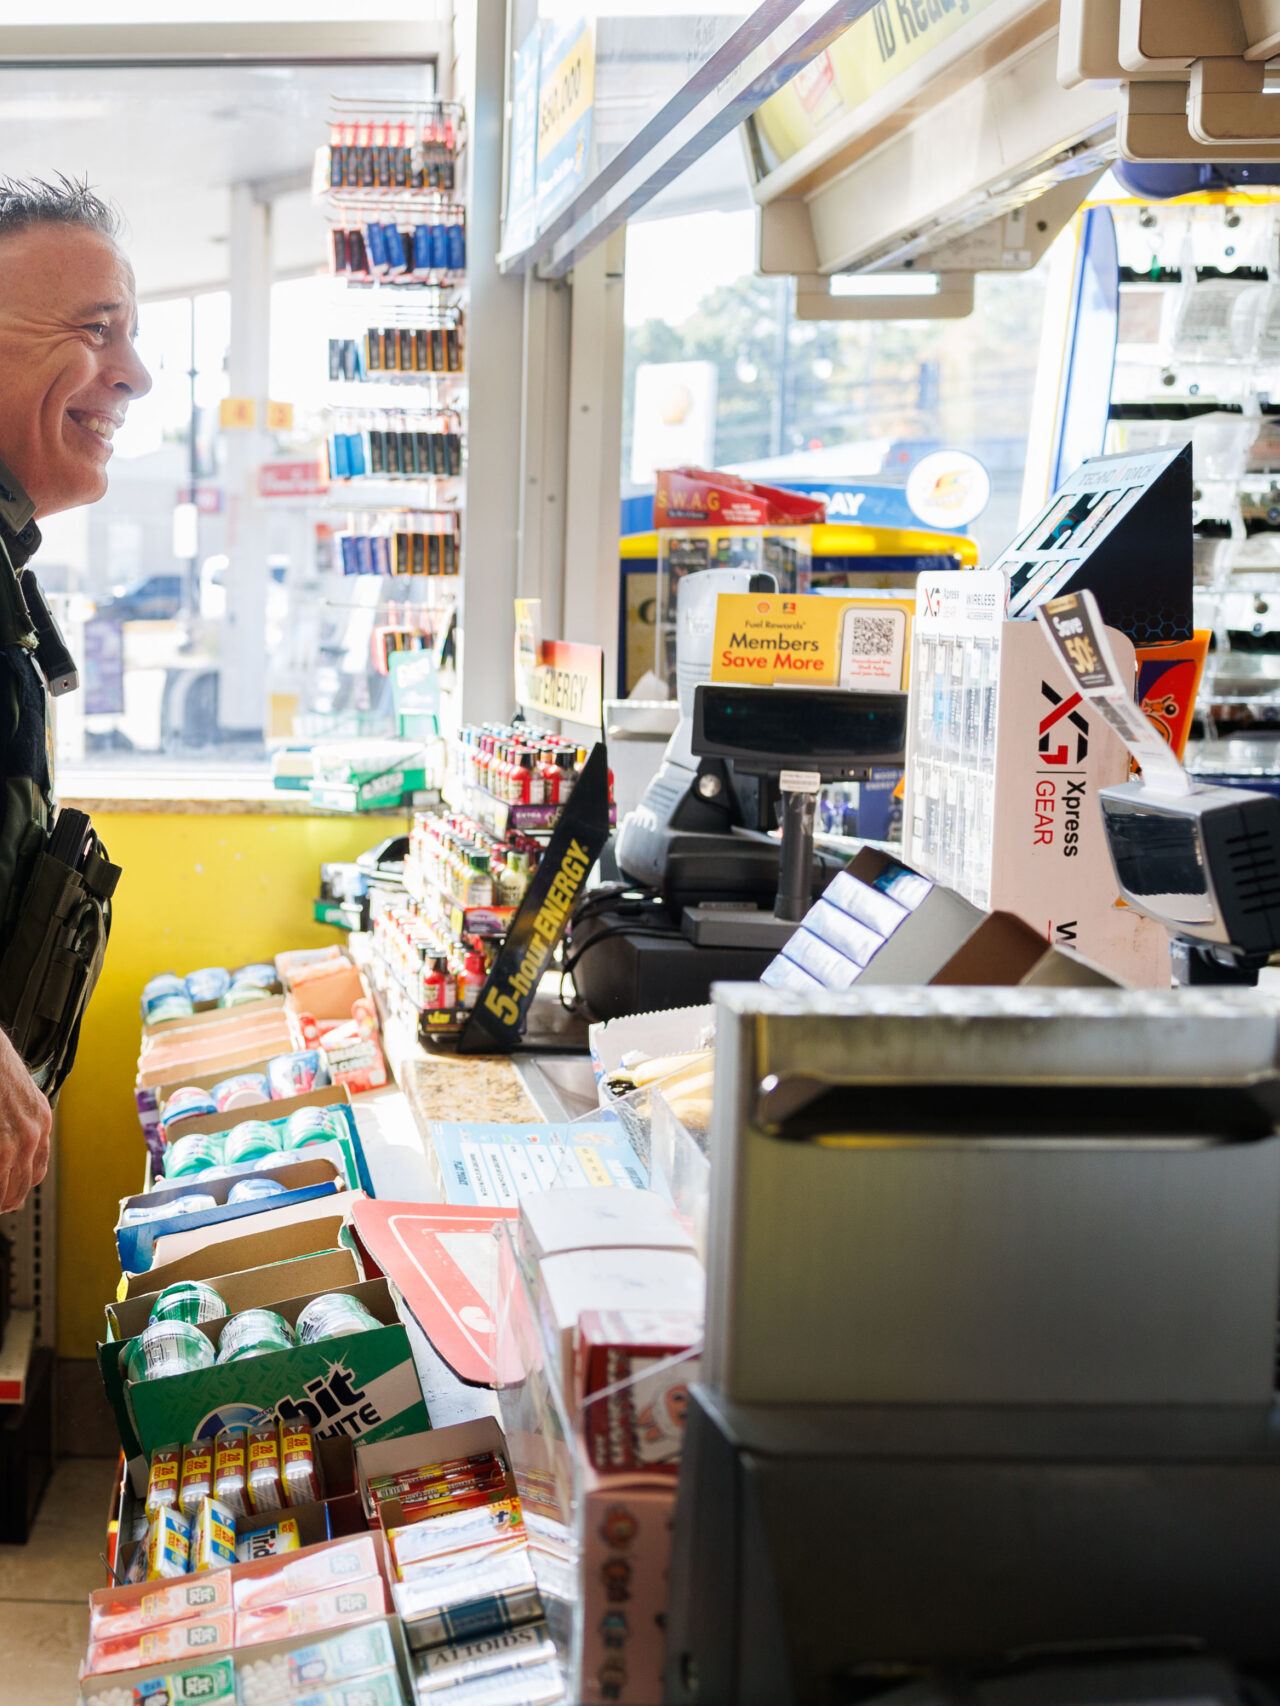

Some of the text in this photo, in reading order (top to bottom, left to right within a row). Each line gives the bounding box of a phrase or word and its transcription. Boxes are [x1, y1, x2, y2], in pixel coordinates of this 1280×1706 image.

[745, 620, 763, 629] Fuel
[1052, 616, 1083, 638] Save
[729, 632, 819, 651] Members
[721, 650, 825, 671] Save More
[544, 668, 588, 713] ENERGY
[516, 812, 541, 820] EXTRA
[1033, 780, 1056, 845] GEAR
[1061, 780, 1086, 857] Xpress
[533, 838, 590, 941] ENERGY
[484, 934, 549, 1026] 5-hour
[273, 1369, 366, 1429] bit
[315, 1403, 382, 1441] HITE
[260, 1444, 274, 1454] 28
[295, 1437, 309, 1447] 28
